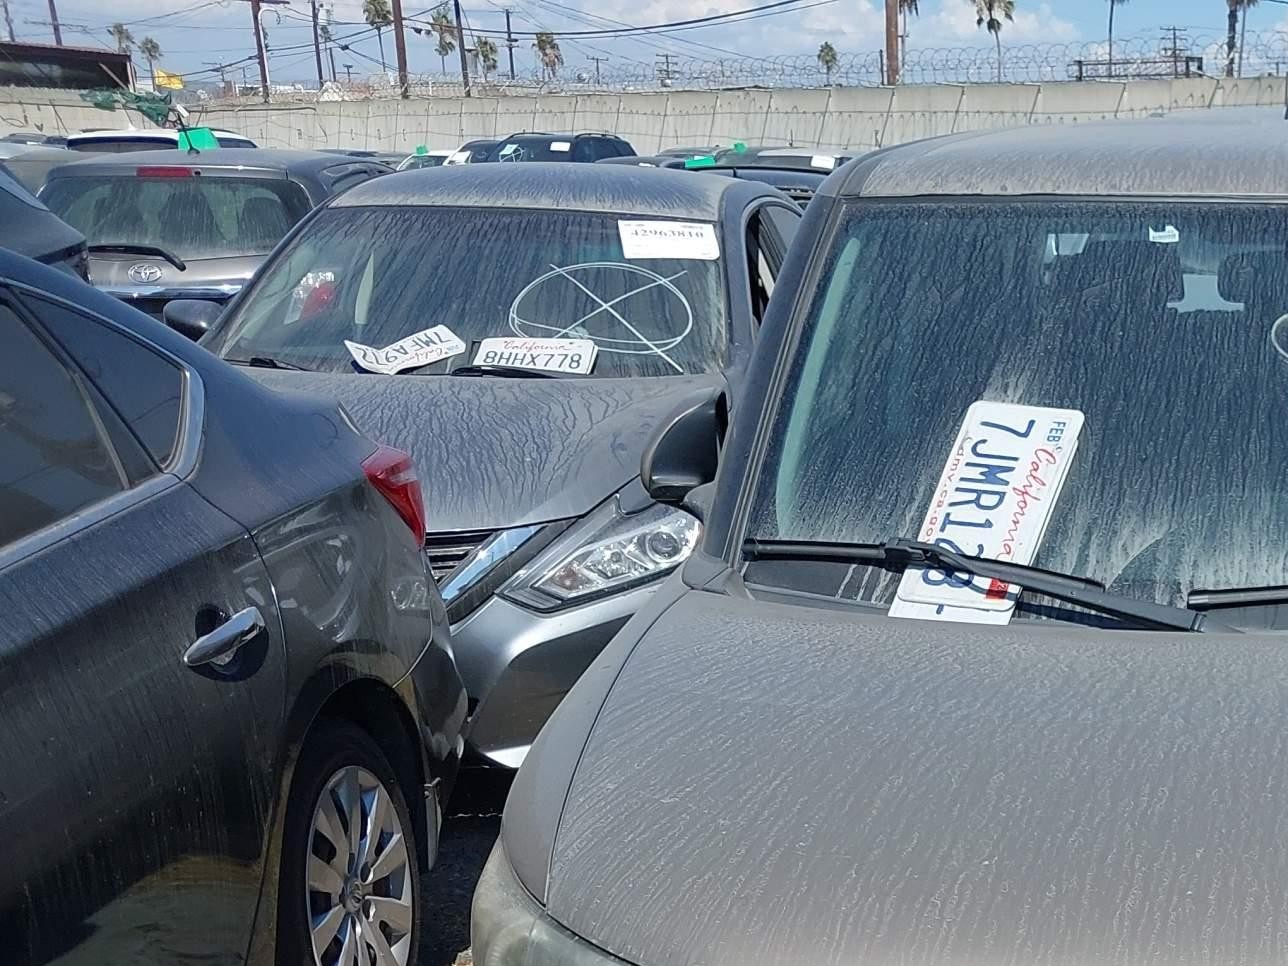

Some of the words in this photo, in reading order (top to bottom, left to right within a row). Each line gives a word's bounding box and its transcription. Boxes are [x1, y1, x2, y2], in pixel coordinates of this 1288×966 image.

[503, 339, 571, 352] California
[482, 350, 584, 370] 8HHX778
[1046, 420, 1067, 443] FEB
